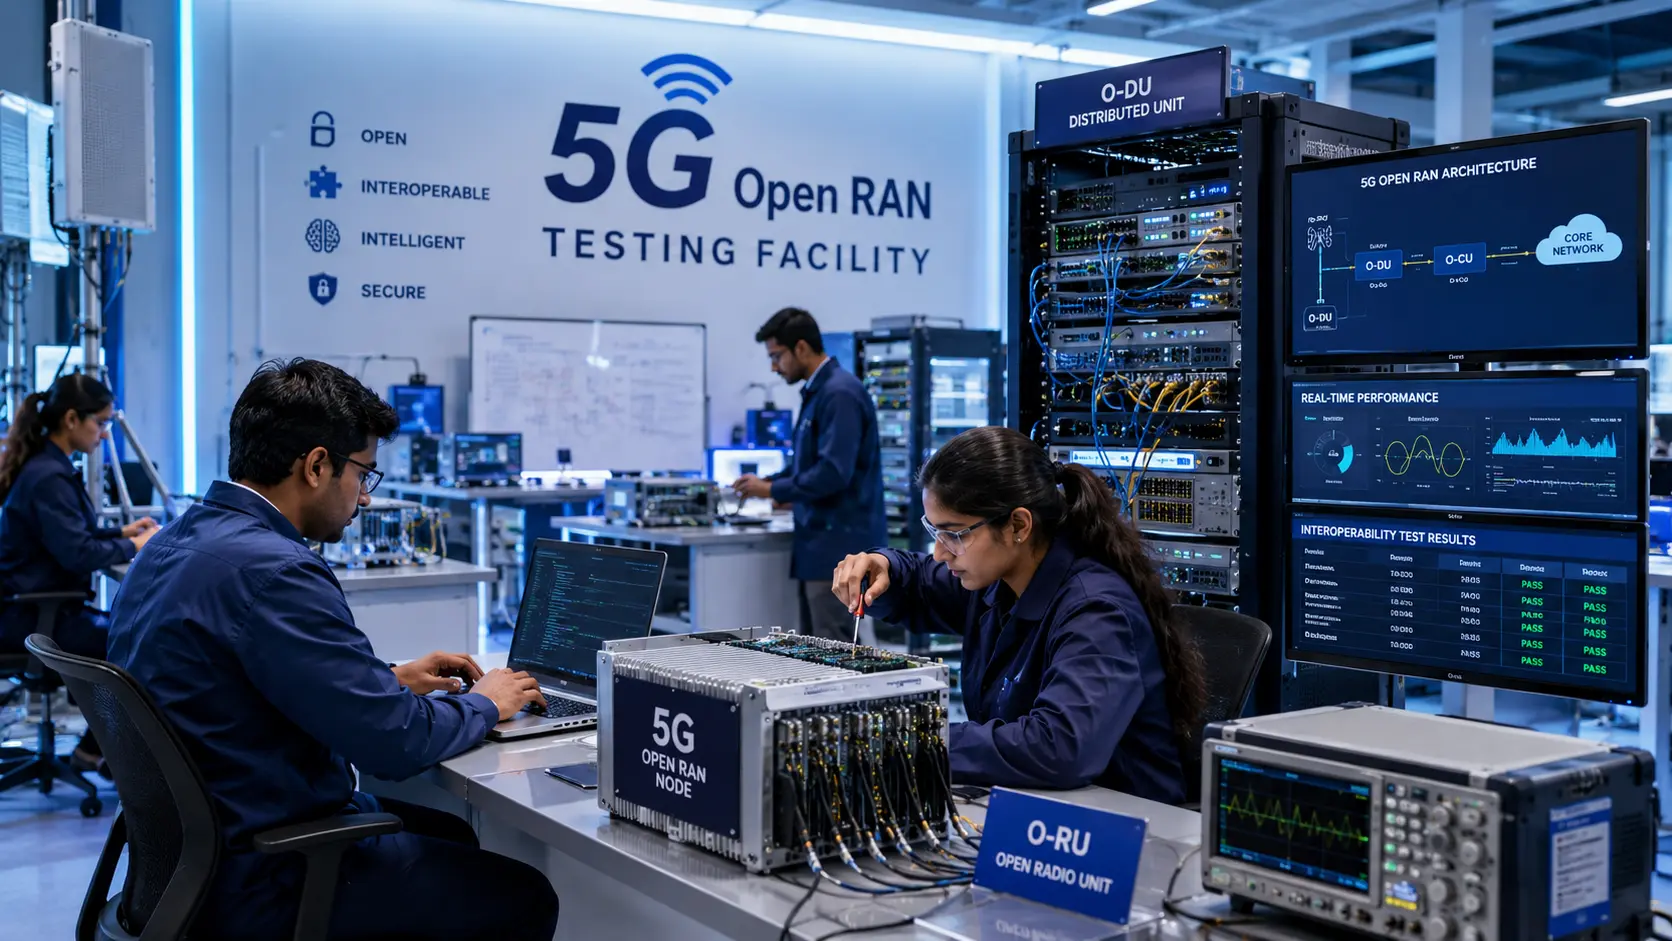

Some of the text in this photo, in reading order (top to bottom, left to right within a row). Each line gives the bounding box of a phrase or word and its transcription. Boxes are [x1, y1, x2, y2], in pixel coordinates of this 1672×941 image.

[1101, 76, 1152, 103] O-DU
[1069, 96, 1185, 128] DISTRIBUTED UNIT
[361, 129, 406, 145] OPEN
[544, 102, 715, 209] 5G
[1361, 157, 1536, 188] 5G OPEN RAN ARCHITECTURE
[362, 180, 489, 200] INTEROPERABLE
[734, 167, 931, 220] Open RAN
[362, 232, 465, 249] INTELLIGENT
[1564, 232, 1593, 243] CORE
[542, 227, 929, 274] TESTING FACILITY
[1553, 243, 1604, 256] NETWORK
[1366, 260, 1391, 270] O-DU
[1446, 253, 1472, 264] O-CU
[362, 284, 425, 299] SECURE
[1309, 313, 1332, 322] O-DU
[1301, 392, 1438, 403] REAL-TIME PERFORMANCE
[1301, 525, 1476, 545] INTEROPERABILITY TEST RESULTS
[1522, 580, 1543, 589] PASS
[1584, 586, 1606, 595] PASS
[1522, 597, 1543, 606] PASS
[1584, 602, 1606, 612] PASS
[1521, 623, 1543, 633] PASS
[1584, 628, 1606, 638] PASS
[1522, 639, 1543, 649] PASS
[1584, 646, 1606, 656] PASS
[1522, 657, 1543, 666] PASS
[1584, 664, 1606, 674] PASS
[652, 706, 695, 754] 5G
[642, 748, 706, 784] OPEN RAN
[655, 772, 692, 798] NODE
[1028, 820, 1091, 856] O-RU
[996, 852, 1113, 893] OPEN RADIO UNIT
